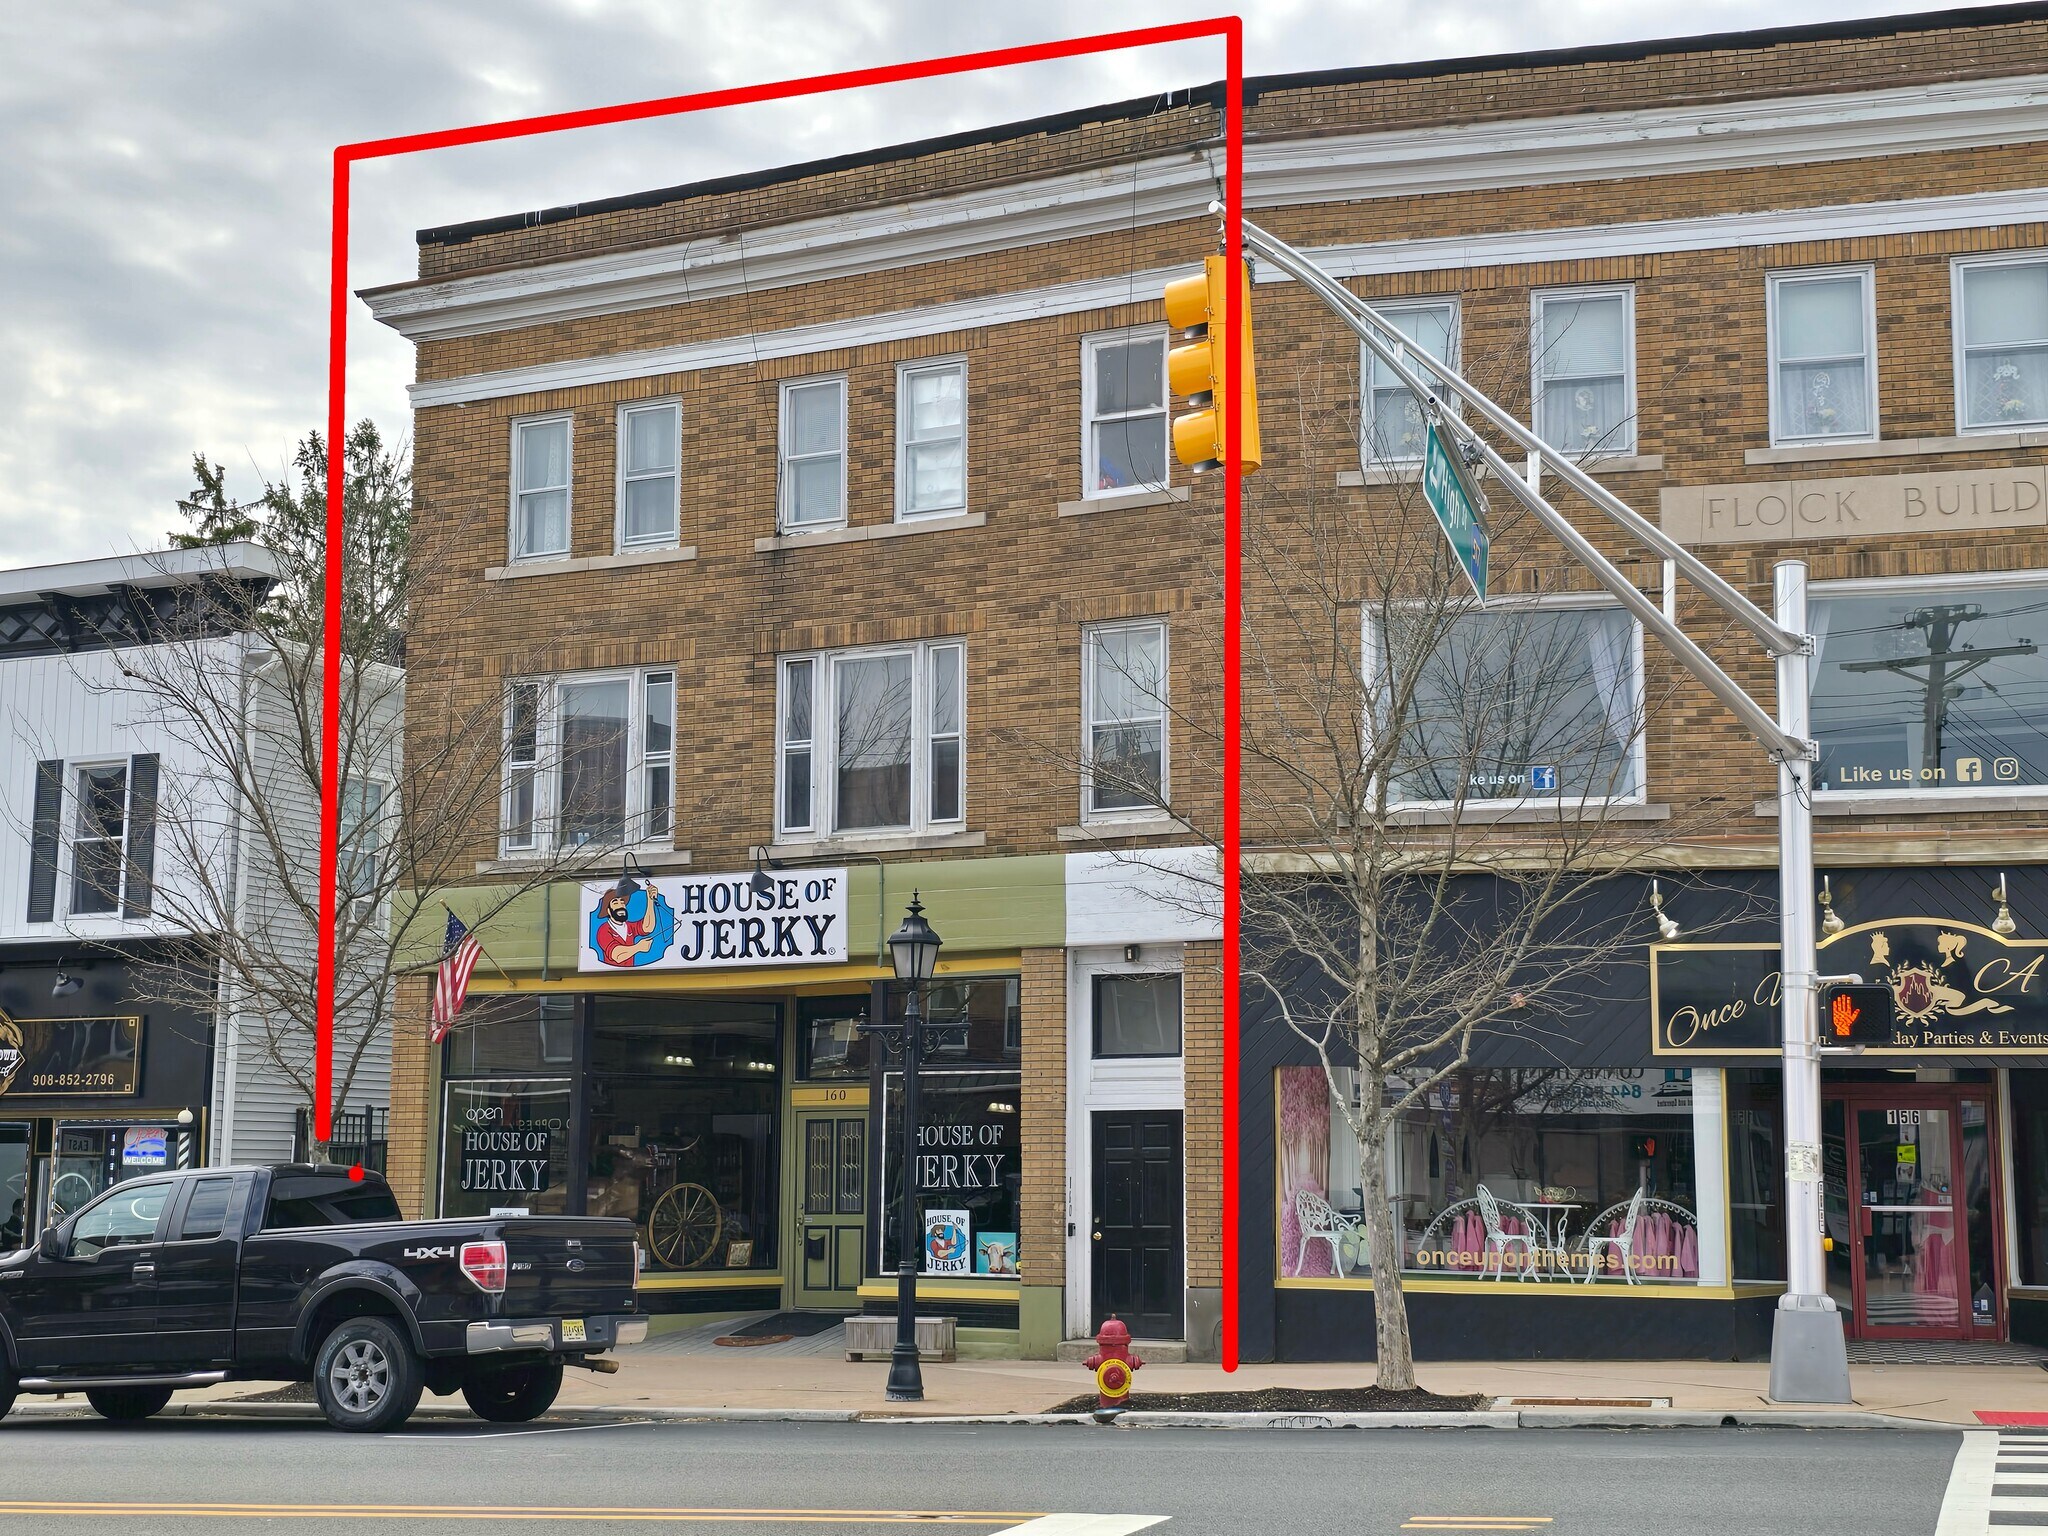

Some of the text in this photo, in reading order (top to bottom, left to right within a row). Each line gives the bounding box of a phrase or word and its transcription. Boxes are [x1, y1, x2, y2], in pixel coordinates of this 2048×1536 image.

[1441, 462, 1461, 529] High
[1708, 480, 2041, 529] FLOCK BUILD
[1489, 775, 1505, 785] us
[1508, 774, 1525, 784] on
[1840, 766, 1883, 783] Like
[1889, 767, 1913, 781] us
[1920, 767, 1946, 780] on
[681, 877, 837, 915] HOUSE OF
[680, 913, 836, 961] JERKY
[1666, 997, 1747, 1048] Once
[1923, 1030, 1974, 1046] Parties
[1979, 1031, 1994, 1045] &
[1998, 1030, 2048, 1045] Events
[32, 1073, 115, 1086] 908-852-2796
[824, 1089, 847, 1101] 160
[465, 1107, 504, 1124] open
[1888, 1110, 1919, 1124] 156
[465, 1131, 548, 1151] HOUSE OF
[979, 1124, 1004, 1146] OF
[123, 1156, 165, 1164] WELCOME
[461, 1159, 548, 1191] JERKY
[926, 1214, 966, 1227] HOUSE OF
[403, 1245, 455, 1259] 4X4
[1416, 1246, 1679, 1271] onceuponthemes.com
[926, 1257, 967, 1272] JERKY
